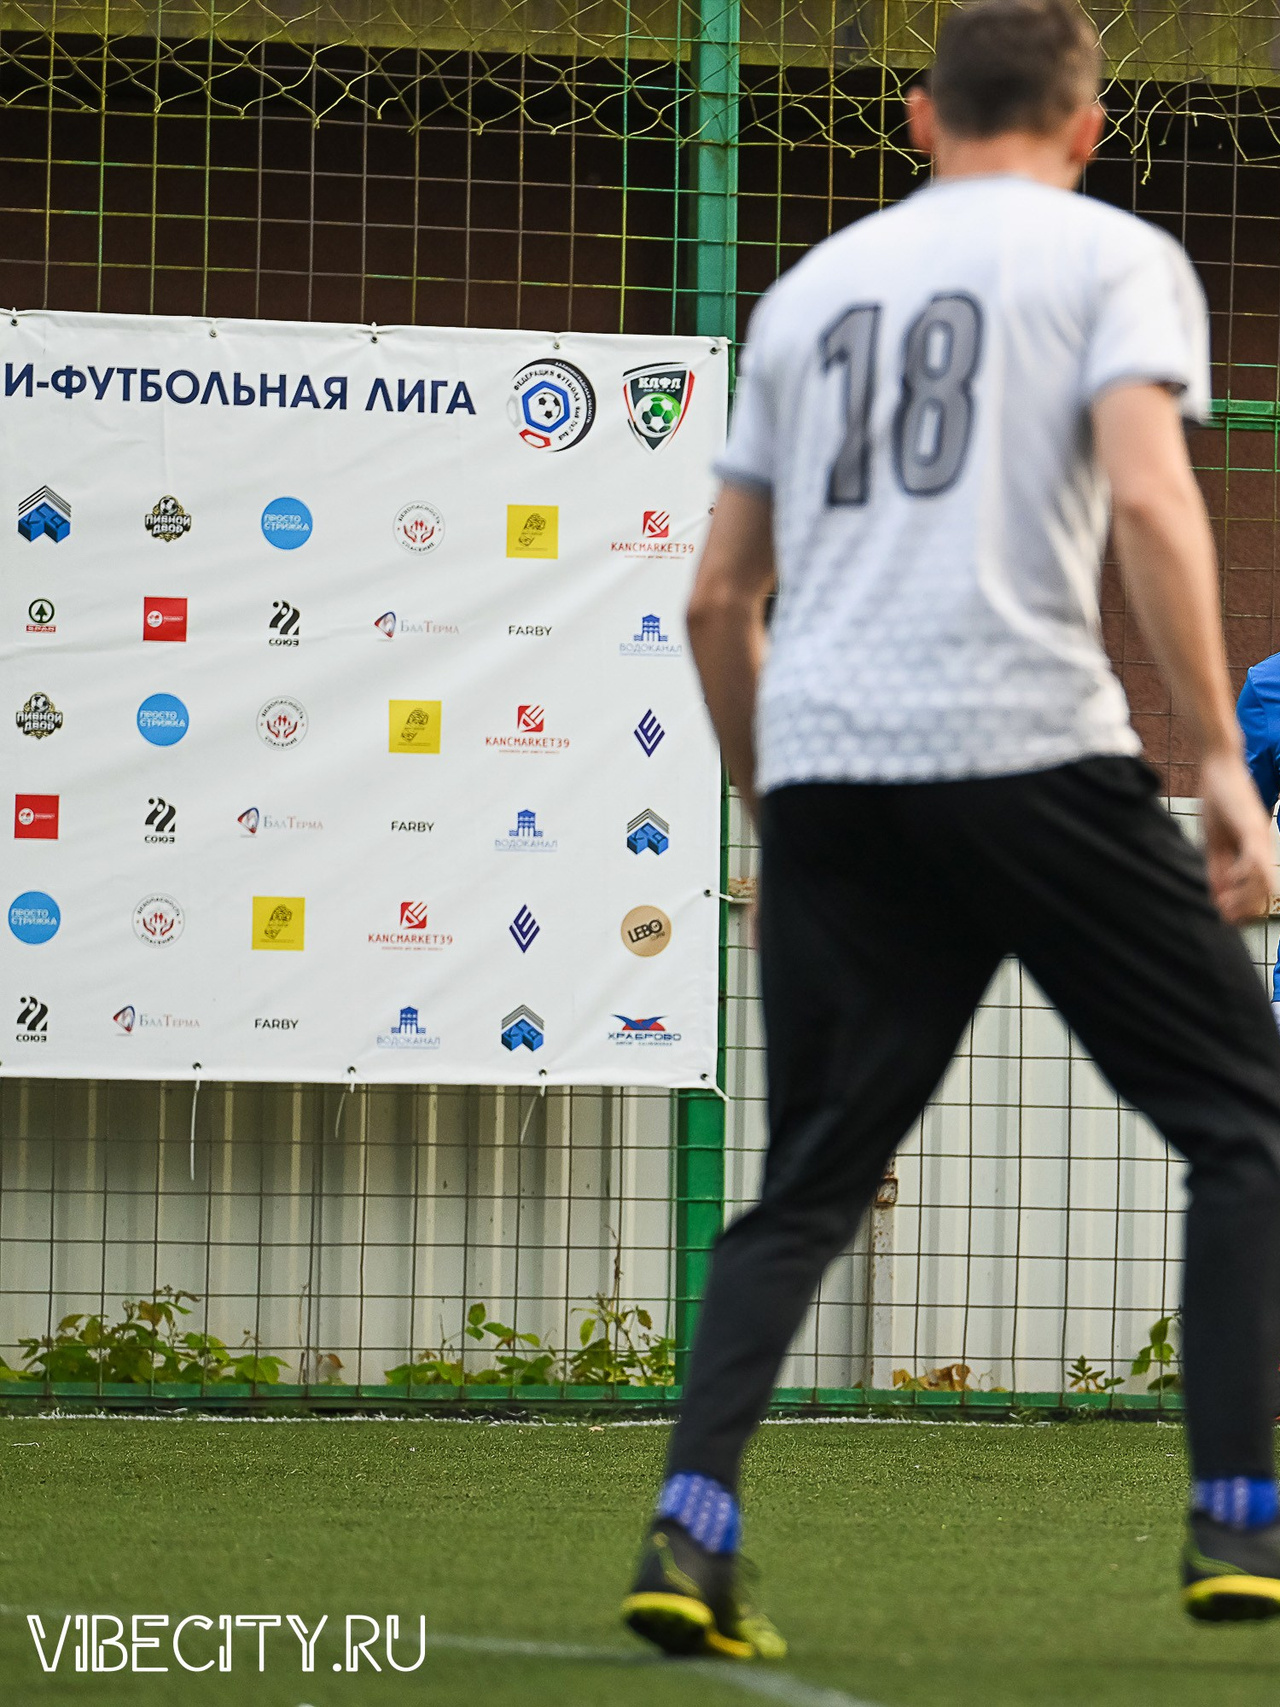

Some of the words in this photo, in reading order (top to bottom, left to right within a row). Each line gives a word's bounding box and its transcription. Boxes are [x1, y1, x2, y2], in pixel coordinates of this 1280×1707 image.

[4, 362, 348, 410] И-ФУТБОЛЬНАЯ
[365, 377, 477, 415] ЛИГА
[638, 377, 682, 389] КЛФЛ
[819, 289, 985, 511] 18
[145, 513, 192, 527] ПИВНОЙ
[264, 514, 301, 523] ПРОСТО
[152, 525, 184, 535] ДВОР
[264, 522, 310, 532] СТРИЖКА
[611, 542, 695, 554] KANCMARKET39
[508, 624, 553, 637] FARBY
[269, 638, 300, 647] СОЮЗ
[619, 642, 682, 654] ВОДОКАНАЛ
[16, 711, 63, 722] ПИВНОЙ
[139, 710, 177, 719] ПРОСТО
[23, 721, 55, 731] ДВОР
[139, 718, 185, 728] СТРИЖКА
[485, 736, 570, 748] KANCMARKET39
[391, 820, 435, 833] FARBY
[144, 835, 175, 844] СОЮЗ
[494, 838, 558, 849] ВОДОКАНАЛ
[11, 909, 49, 918] ПРОСТО
[11, 916, 57, 926] СТРИЖКА
[627, 918, 663, 944] LEBO
[368, 933, 453, 945] KANCMARKET39
[254, 1018, 300, 1031] FARBY
[16, 1034, 47, 1043] СОЮЗ
[376, 1035, 441, 1047] ВОДОКАНАЛ
[607, 1032, 683, 1042] ХРАБРОВО
